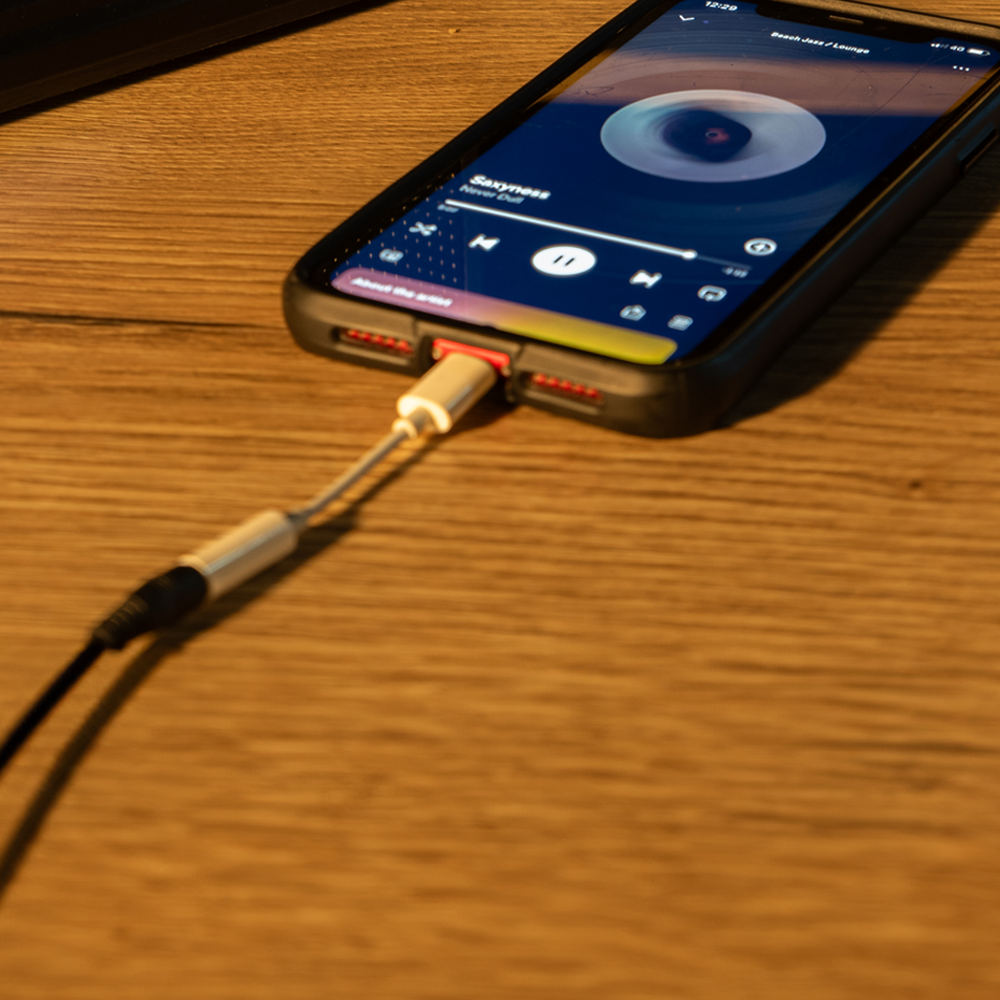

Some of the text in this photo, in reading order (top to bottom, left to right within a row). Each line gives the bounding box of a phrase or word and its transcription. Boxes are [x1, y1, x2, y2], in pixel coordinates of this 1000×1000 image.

[704, 0, 738, 12] 12:29
[770, 31, 801, 42] Beach
[832, 42, 870, 54] Lounge
[469, 174, 551, 200] Saxyness
